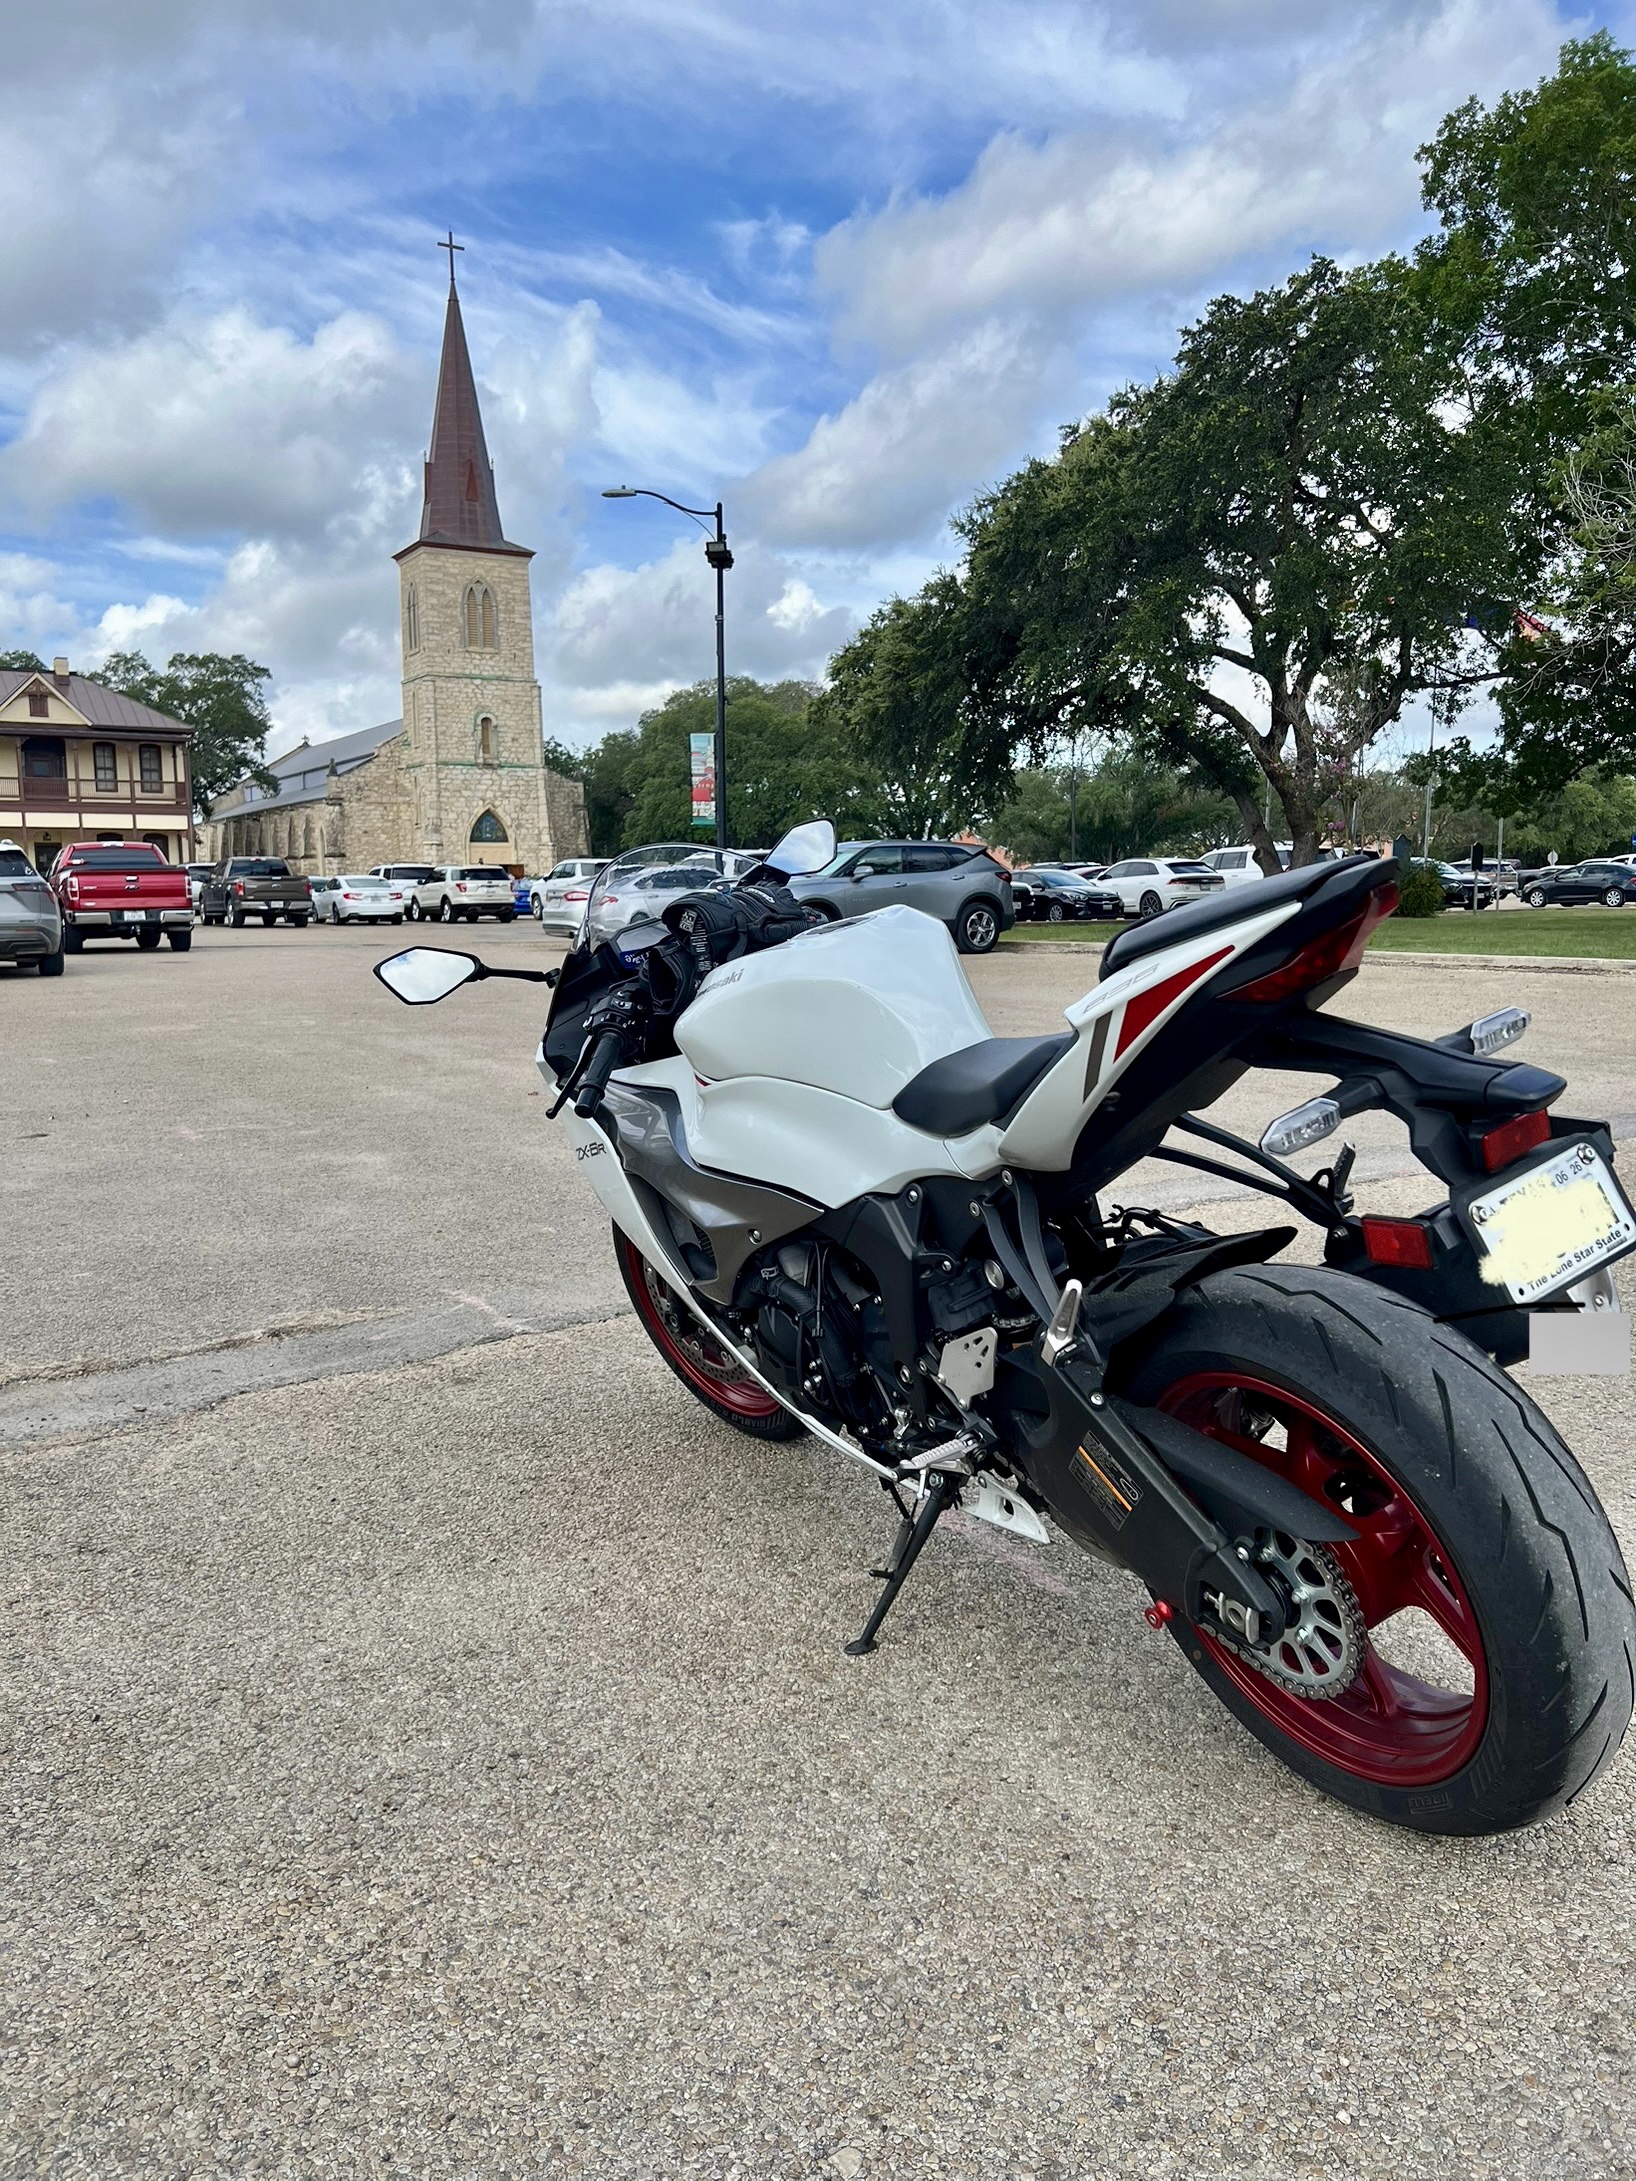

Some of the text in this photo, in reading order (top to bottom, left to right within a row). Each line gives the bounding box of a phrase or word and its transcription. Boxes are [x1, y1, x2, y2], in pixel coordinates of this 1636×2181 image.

[697, 968, 745, 998] wasaki
[576, 1142, 607, 1161] ZX-6R
[1555, 1161, 1583, 1185] 06 26
[1573, 1247, 1595, 1263] Star
[1595, 1228, 1622, 1249] State
